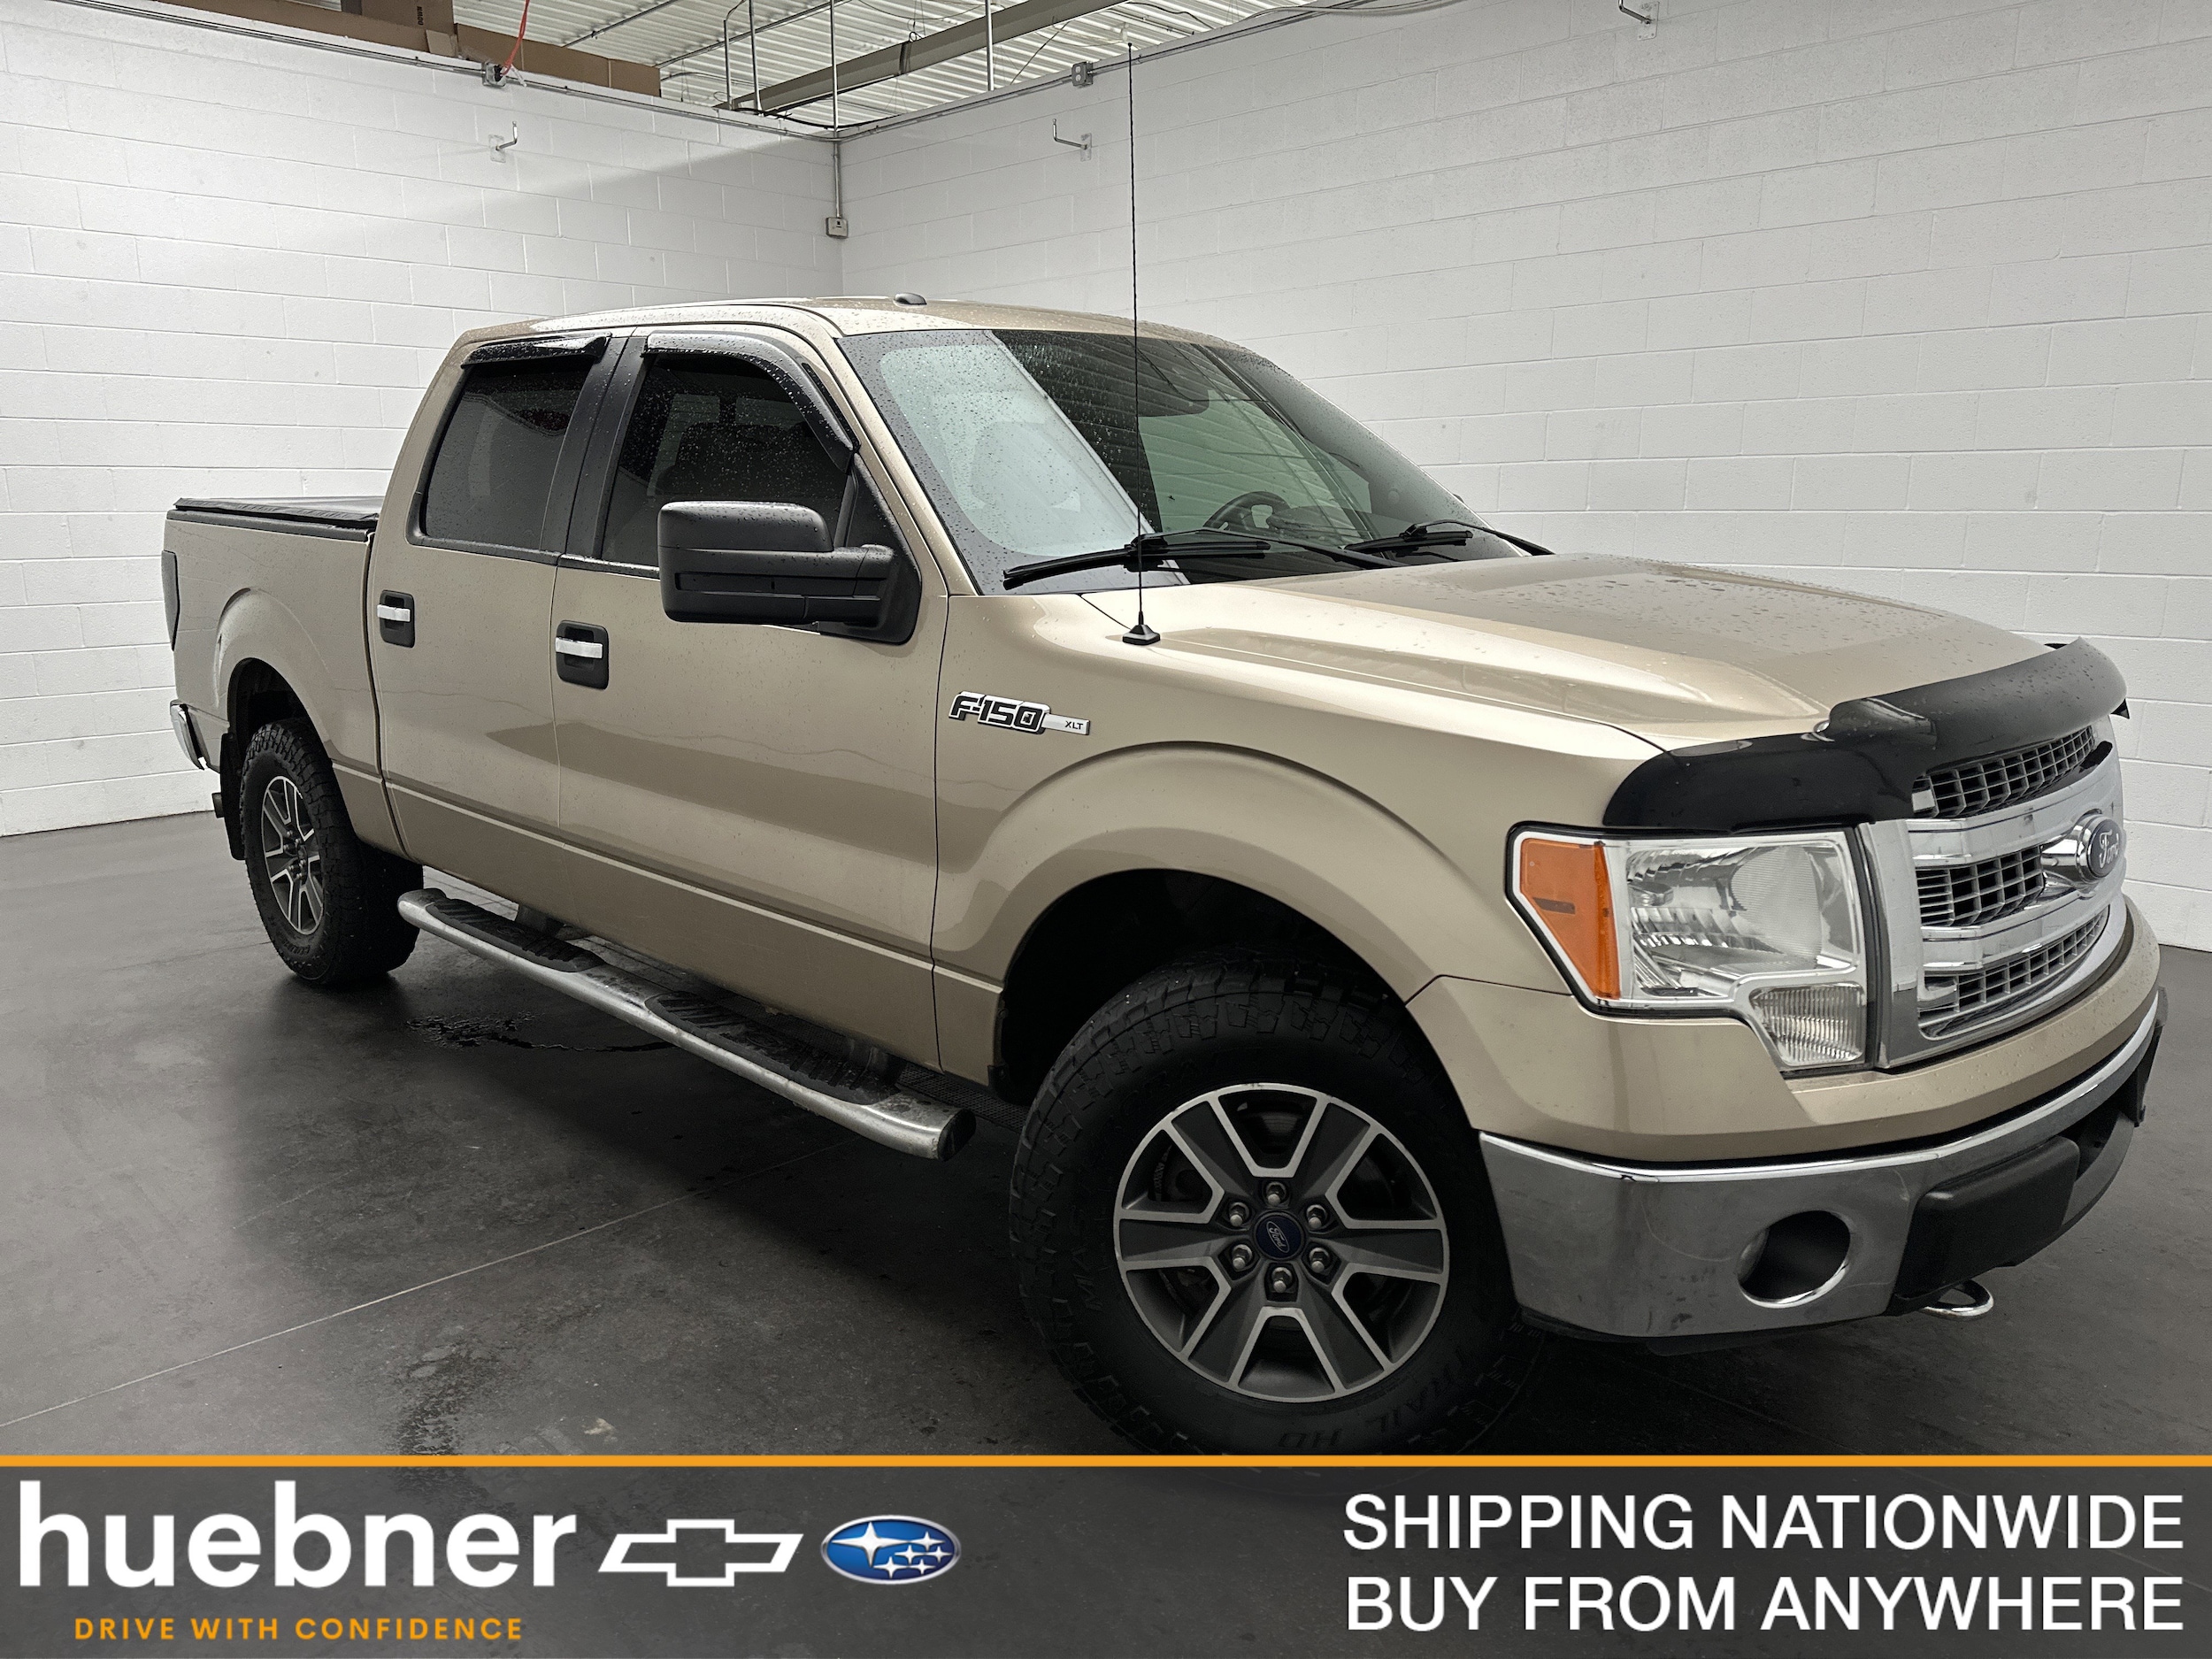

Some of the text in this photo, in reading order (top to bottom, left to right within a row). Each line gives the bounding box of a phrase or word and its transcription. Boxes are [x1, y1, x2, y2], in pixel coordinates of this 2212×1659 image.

[949, 692, 1084, 734] F-150 XLT
[2099, 829, 2120, 869] Ford
[1277, 1427, 1342, 1449] HD
